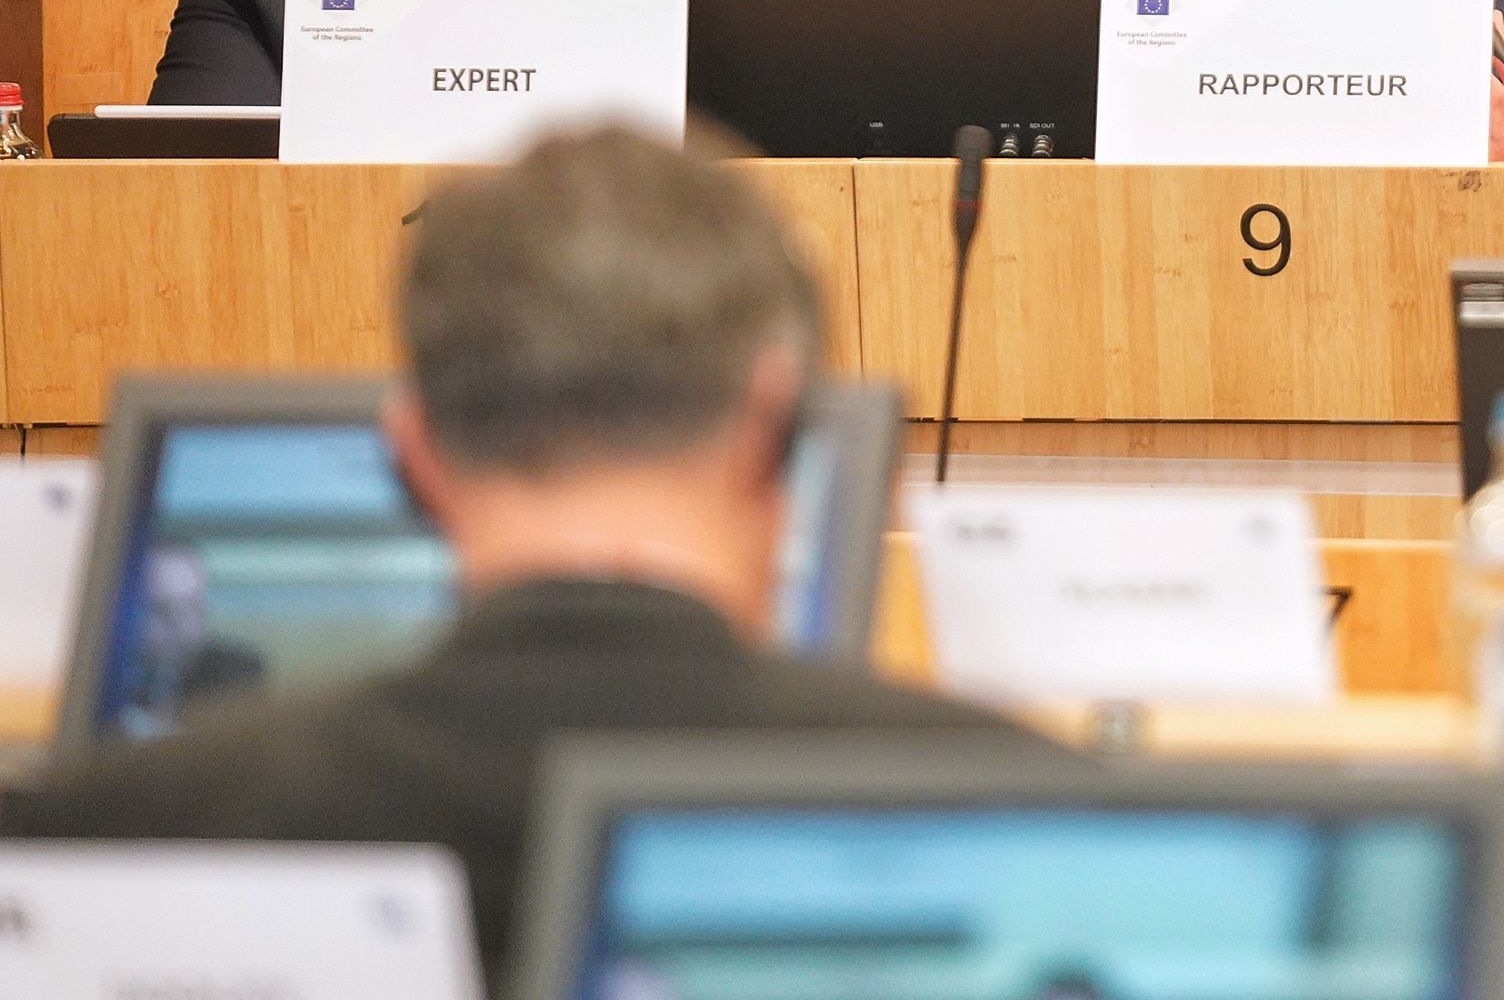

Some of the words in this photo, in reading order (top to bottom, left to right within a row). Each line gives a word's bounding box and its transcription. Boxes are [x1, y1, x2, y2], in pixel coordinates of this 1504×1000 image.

[433, 68, 537, 93] EXPERT
[1199, 74, 1408, 97] RAPPORTEUR
[1240, 204, 1292, 277] 9
